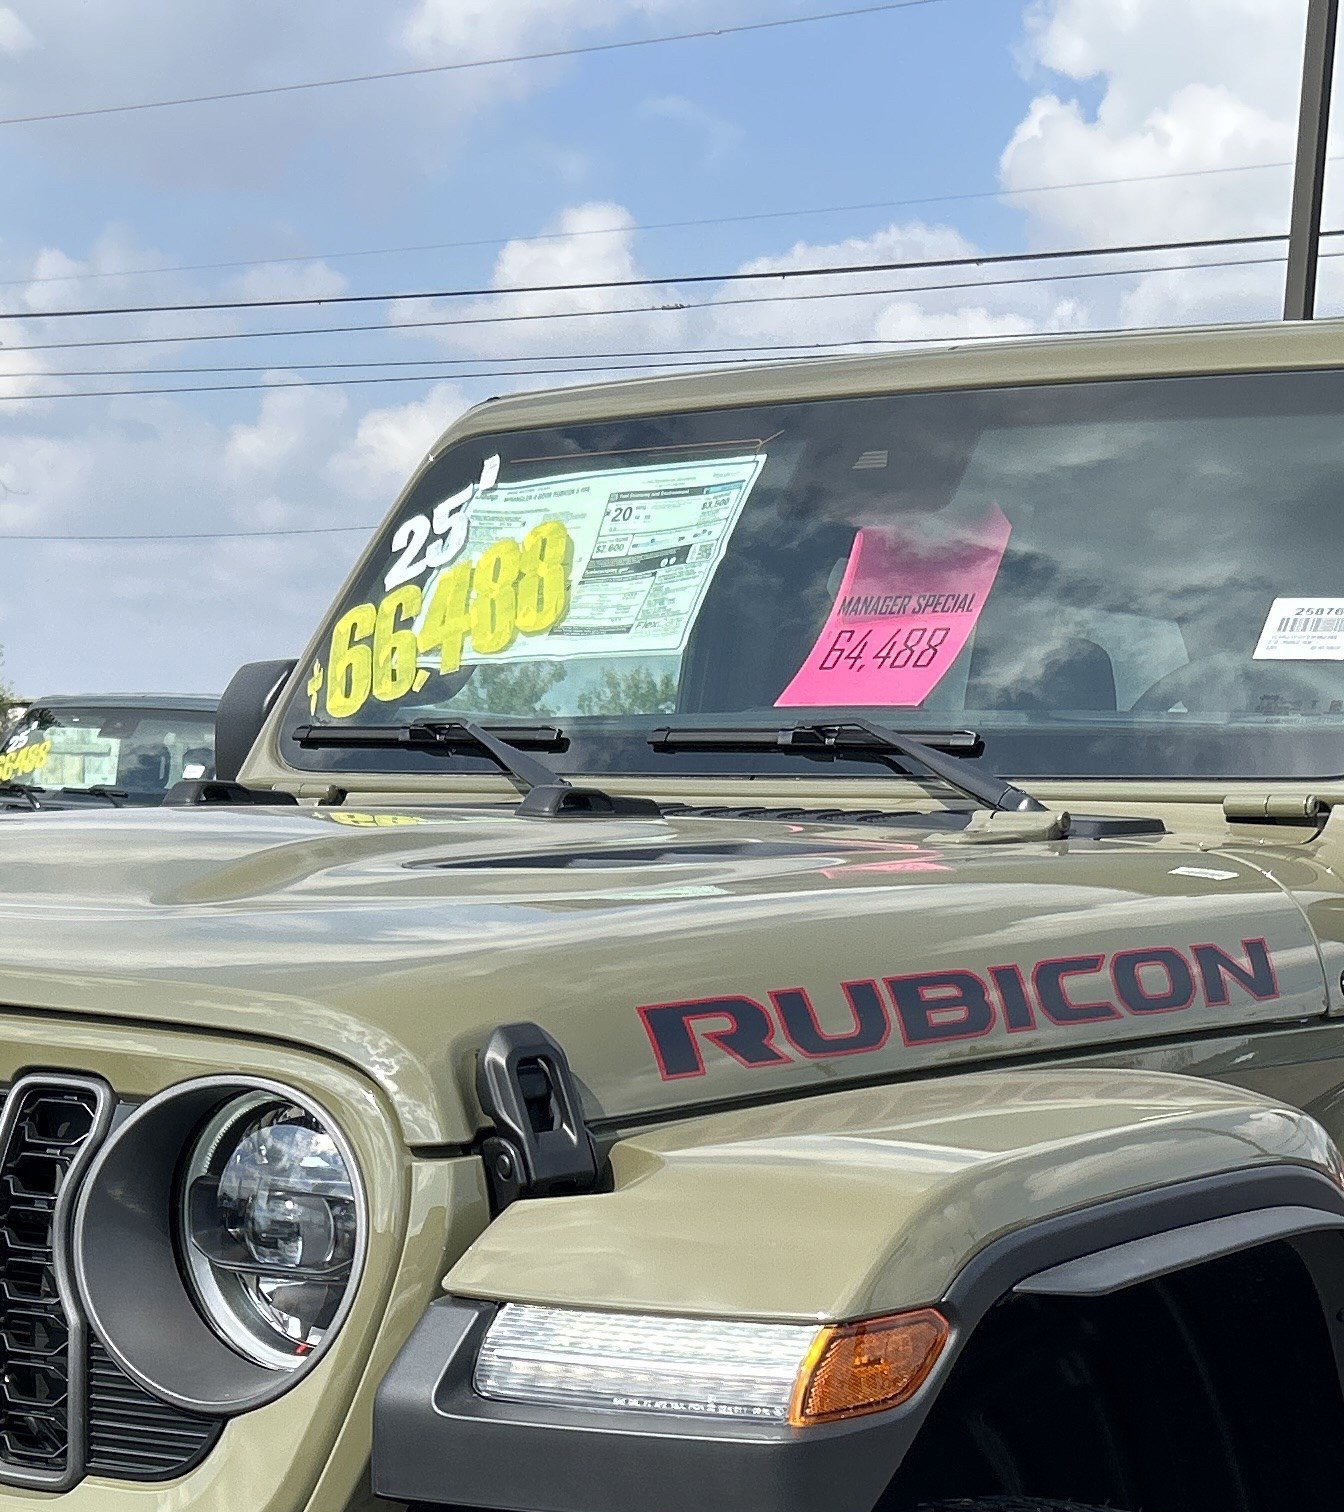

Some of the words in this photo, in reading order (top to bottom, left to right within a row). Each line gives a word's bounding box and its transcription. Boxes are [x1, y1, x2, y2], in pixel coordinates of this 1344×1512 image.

[611, 506, 633, 523] 20
[838, 594, 911, 616] MANAGER
[912, 593, 976, 614] SPECIAL
[819, 627, 950, 672] 64,488
[636, 937, 1279, 1081] RUBICON
